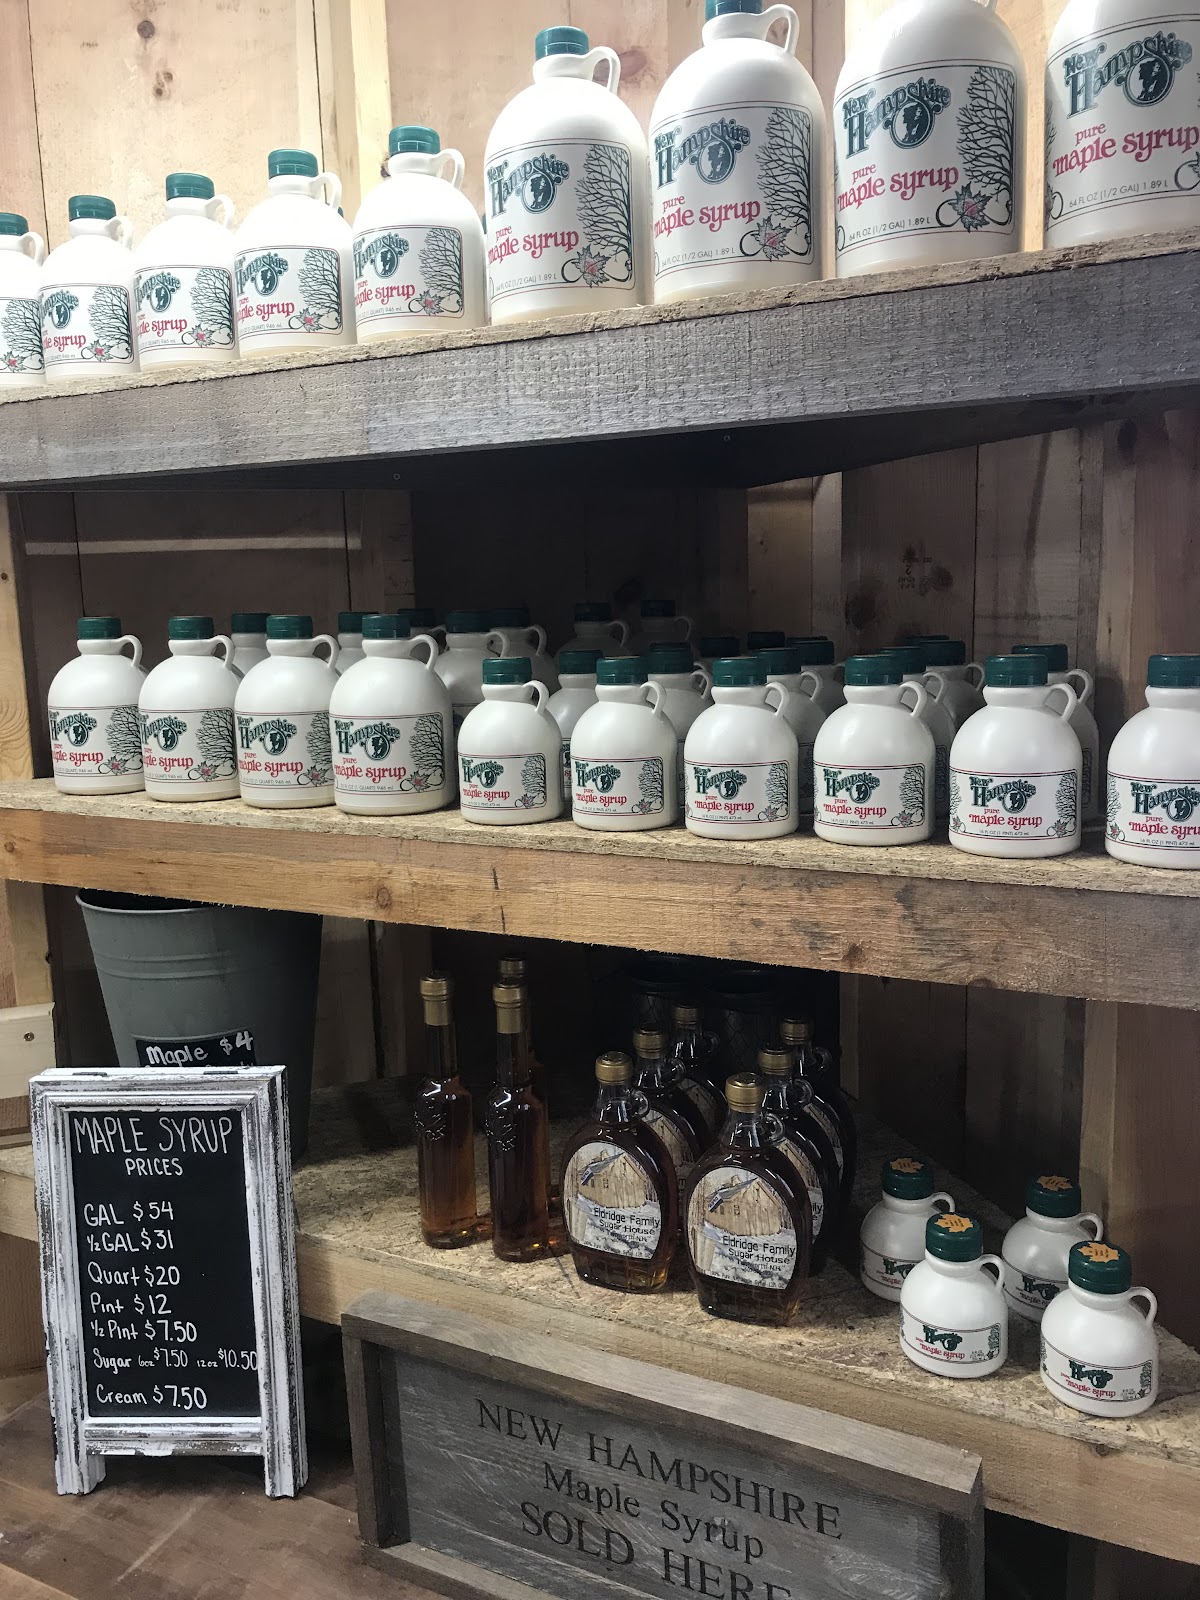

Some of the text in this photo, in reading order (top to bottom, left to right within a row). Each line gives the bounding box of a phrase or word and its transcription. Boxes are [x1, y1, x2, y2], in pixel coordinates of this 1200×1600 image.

[1063, 42, 1106, 78] New
[843, 88, 876, 118] New
[1075, 123, 1106, 147] pure
[1052, 125, 1199, 177] maple syrup
[852, 163, 877, 184] pure
[838, 165, 959, 213] maple syrup
[1078, 197, 1085, 206] FL
[1086, 192, 1098, 203] OZ
[662, 195, 685, 214] pure
[699, 200, 760, 232] syrup
[495, 226, 512, 241] pure
[862, 228, 872, 237] OZ
[523, 230, 579, 259] syrup
[375, 284, 415, 305] syrup
[256, 302, 295, 322] syrup
[151, 319, 188, 337] syrup
[54, 335, 86, 352] syrup
[69, 752, 104, 767] syrup
[159, 756, 194, 772] syrup
[264, 761, 304, 778] syrup
[365, 766, 407, 784] syrup
[483, 790, 510, 802] syrup
[599, 796, 627, 807] syrup
[694, 800, 755, 815] maple syrup
[823, 804, 887, 820] maple syrup
[969, 813, 1043, 831] maple syrup
[1128, 821, 1200, 841] maple syru
[146, 1030, 254, 1067] Maple $4
[73, 1116, 233, 1154] MAPLE SYRUP
[124, 1157, 184, 1176] PRICES
[83, 1200, 174, 1227] GAL $54
[593, 1207, 661, 1229] Eldridge Family
[599, 1218, 656, 1236] Sugar House
[140, 1227, 174, 1251] $31
[722, 1234, 796, 1258] Eldridge Family
[728, 1248, 791, 1265] Sugar House
[87, 1261, 181, 1288] Quart $20
[90, 1291, 172, 1316] Pint $12
[107, 1319, 139, 1341] Pint
[144, 1318, 198, 1343] $7.50
[92, 1346, 258, 1375] Sugar 6oz $7.50 12oz $10.50
[96, 1383, 208, 1411] Cream $7.50
[475, 1398, 843, 1540] NEW HAMPSHIRE
[542, 1461, 764, 1565] Maple Syrup
[520, 1500, 636, 1566] SOLD
